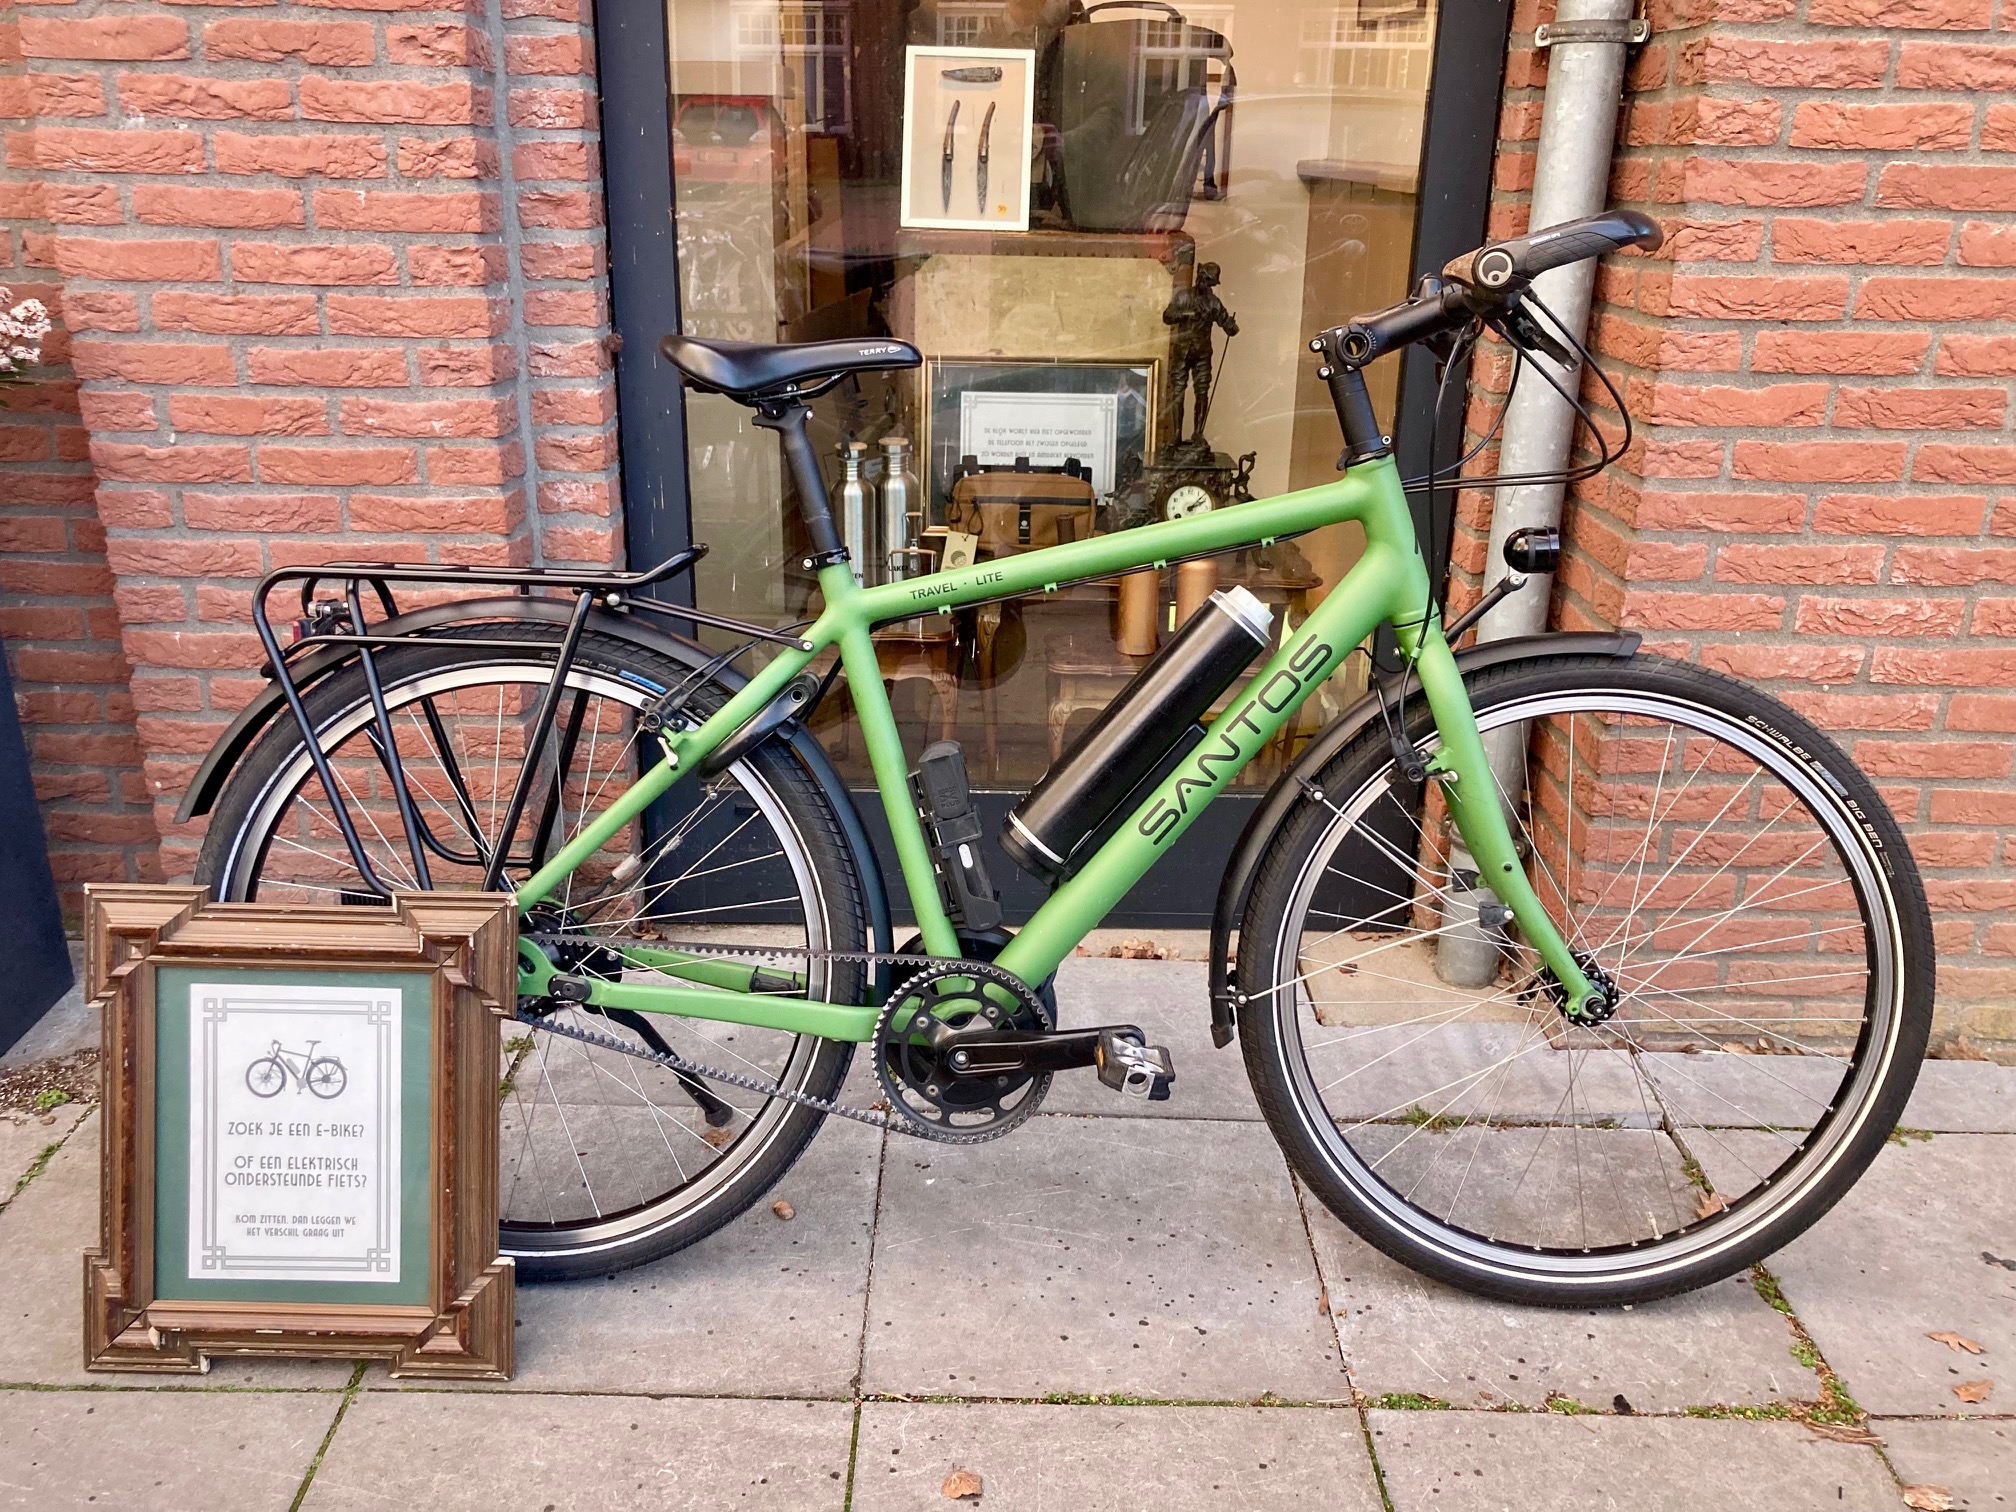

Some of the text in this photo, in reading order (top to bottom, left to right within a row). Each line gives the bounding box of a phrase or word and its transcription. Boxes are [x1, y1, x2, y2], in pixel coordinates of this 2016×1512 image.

[859, 347, 886, 356] TERRY
[910, 572, 1003, 599] TRAVEL LITE
[540, 653, 616, 673] SCWALBE
[1138, 634, 1333, 845] SANTOS
[1745, 715, 1883, 848] SCHWALBE BIG BEN
[228, 1122, 364, 1137] ZOEK JE EEN E-BIKE?
[234, 1156, 358, 1170] OF EEN ELEKTRISCH
[225, 1173, 367, 1188] ONDERSTEUNDE FIETS?
[236, 1215, 256, 1223] KOM
[292, 1216, 308, 1224] DAN
[312, 1216, 341, 1224] LEGGEN
[345, 1217, 356, 1225] WE
[247, 1227, 344, 1237] HET VERSCHIL GRAAG UIT
